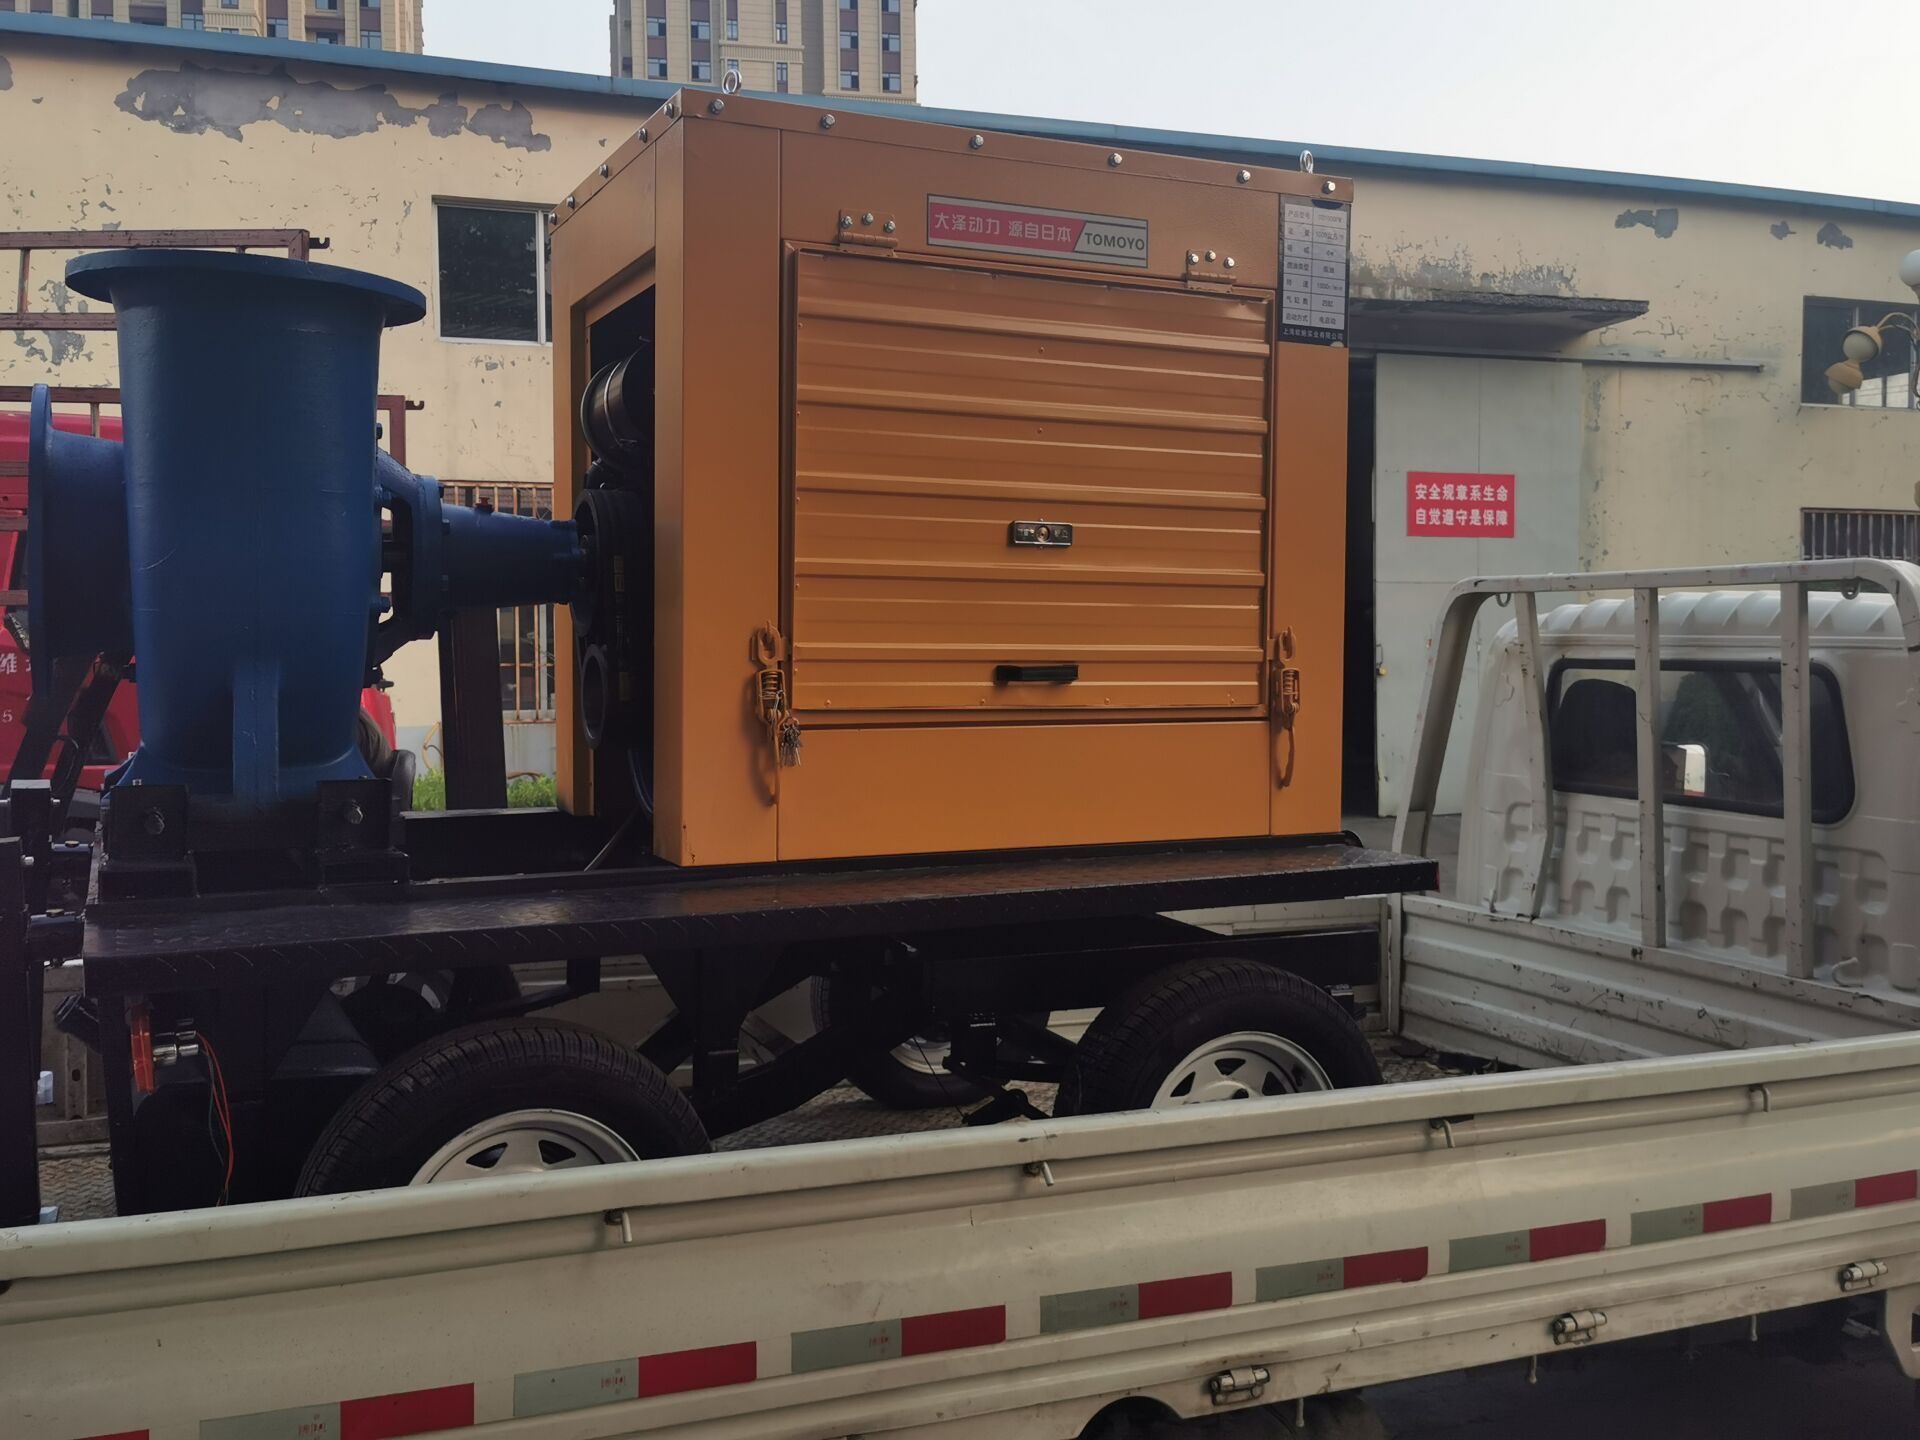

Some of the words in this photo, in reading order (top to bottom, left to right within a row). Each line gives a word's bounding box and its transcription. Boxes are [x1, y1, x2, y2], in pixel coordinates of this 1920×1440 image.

[935, 212, 1000, 235] 大泽动力
[1008, 220, 1072, 243] 源自日本
[1084, 232, 1145, 251] TOMOYO
[1415, 483, 1508, 502] 安全规章系生命
[1415, 508, 1508, 527] 自觉遵守是保障
